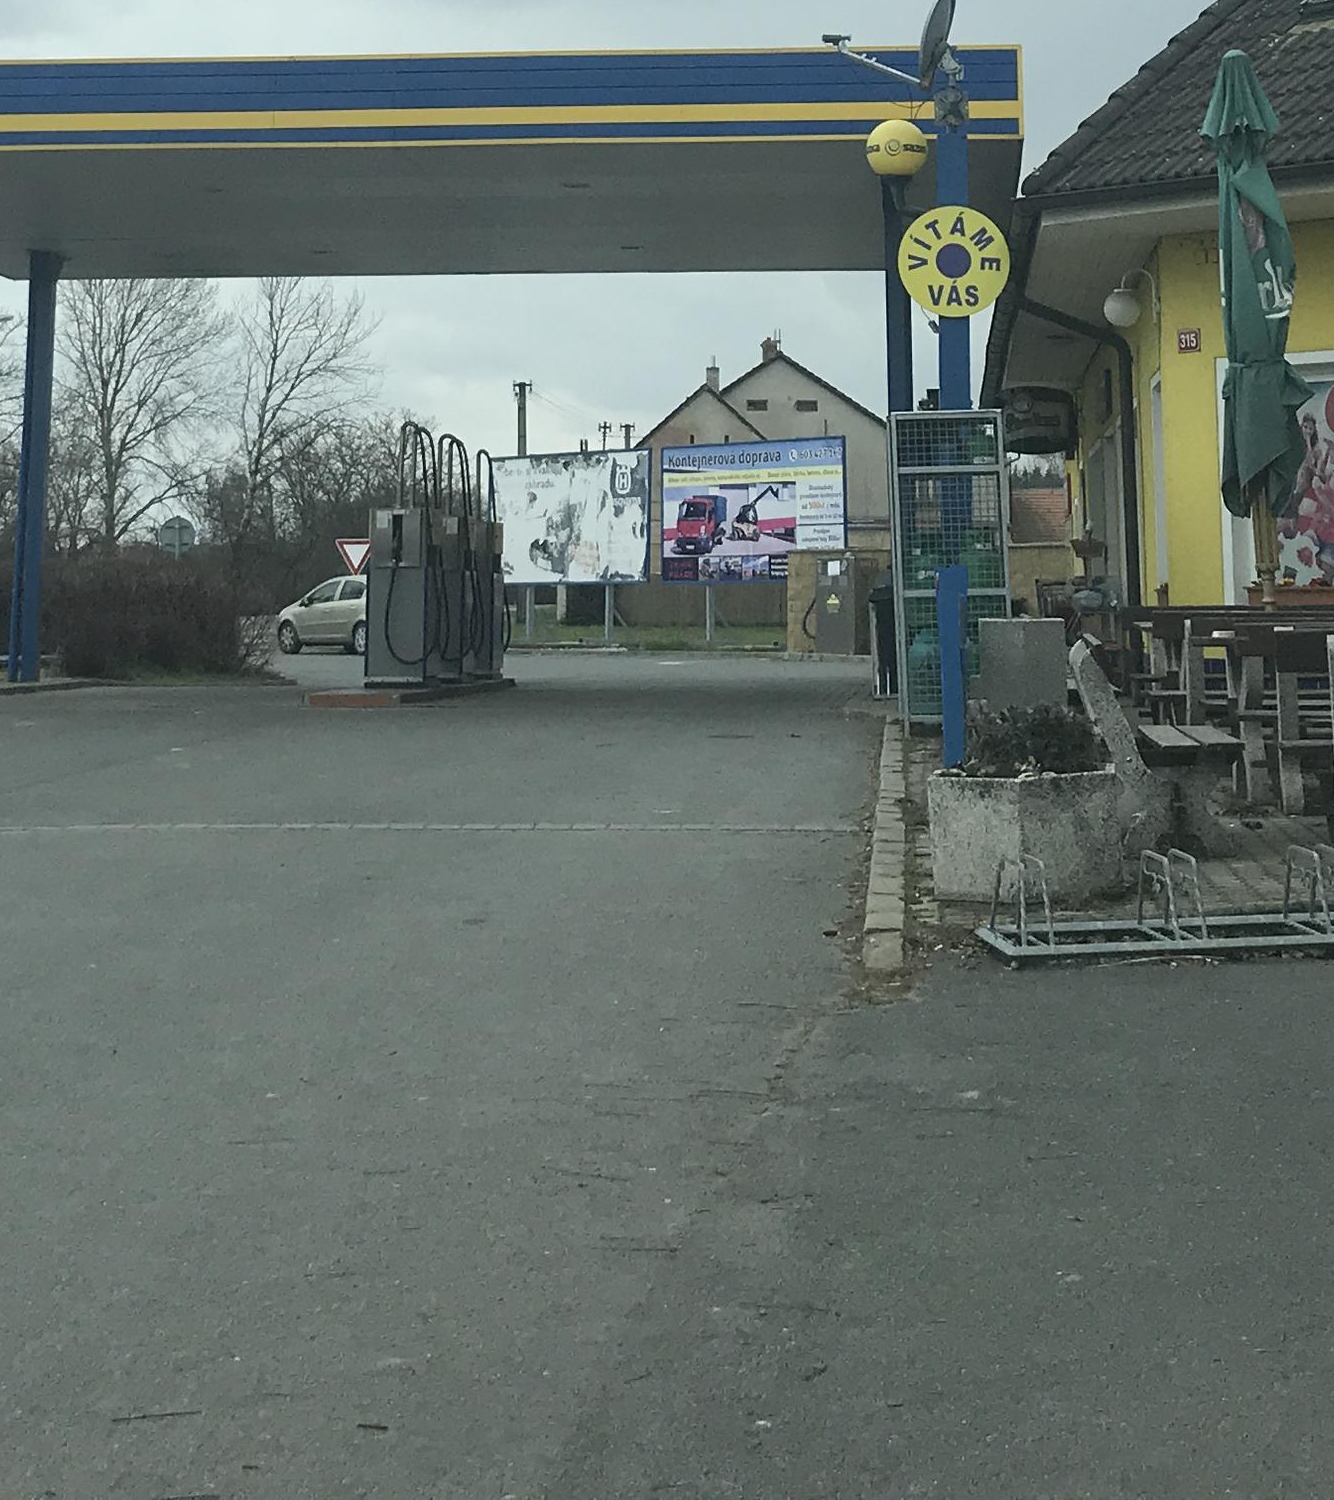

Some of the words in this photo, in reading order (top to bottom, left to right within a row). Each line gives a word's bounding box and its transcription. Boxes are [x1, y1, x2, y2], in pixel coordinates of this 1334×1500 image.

[908, 211, 1001, 272] VÍTÁME
[927, 279, 979, 307] VÁS
[1179, 333, 1197, 348] 315
[668, 450, 736, 470] Kontejnerová
[738, 449, 781, 467] doprava
